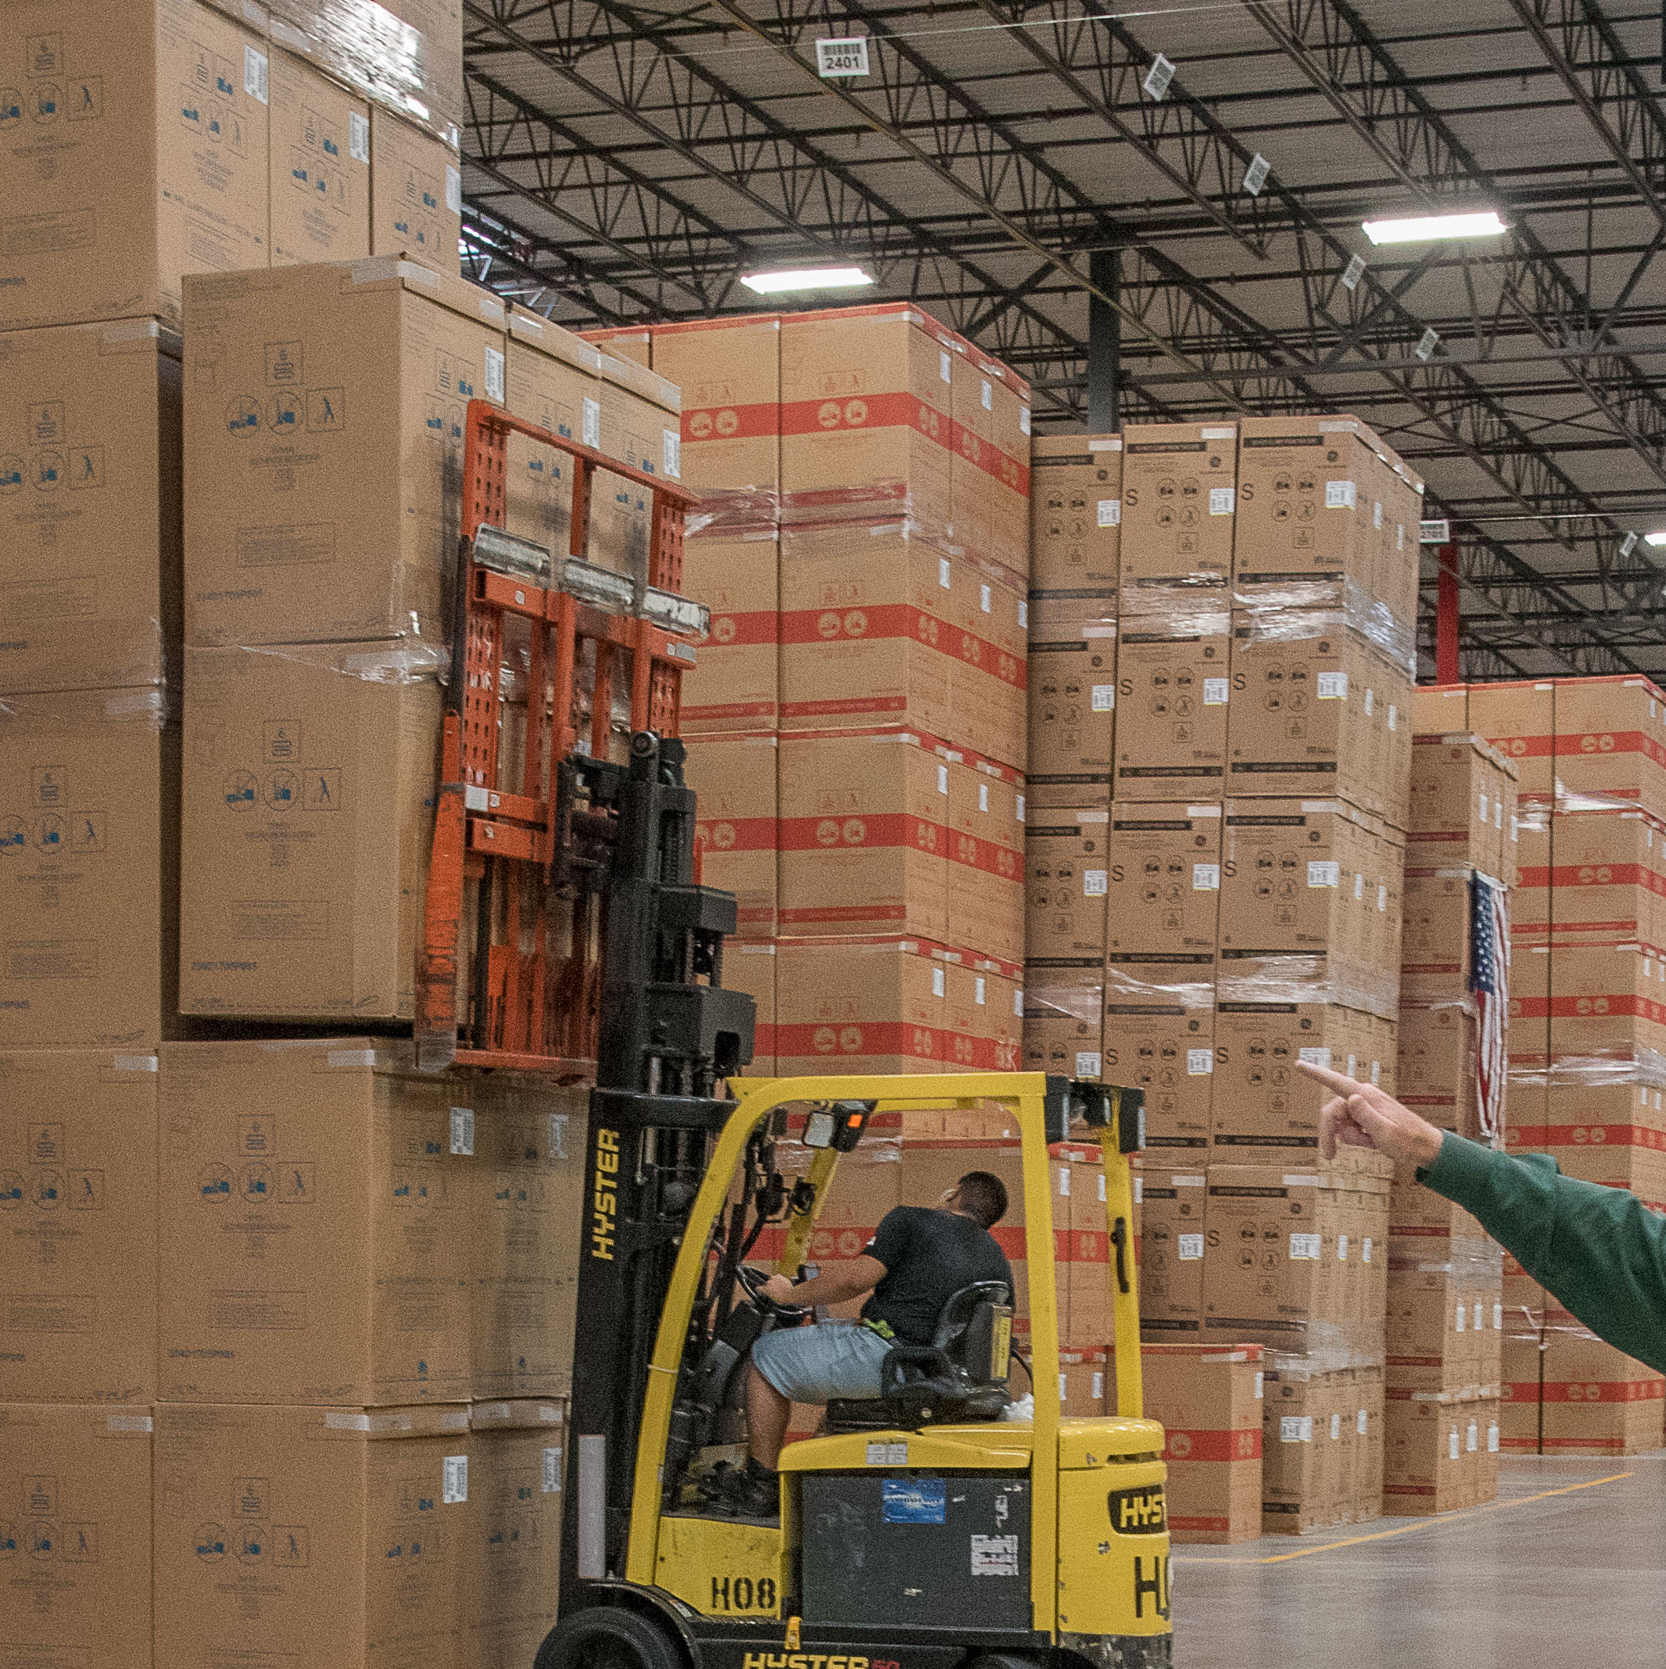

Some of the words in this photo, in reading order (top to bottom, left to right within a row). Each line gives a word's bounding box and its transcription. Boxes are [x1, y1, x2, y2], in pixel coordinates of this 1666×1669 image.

[826, 55, 860, 71] 2401
[1124, 489, 1139, 507] S
[1240, 483, 1255, 501] S
[1119, 678, 1134, 696] S
[1233, 673, 1247, 691] S
[1112, 865, 1125, 882] S
[1225, 861, 1238, 878] S
[1105, 1048, 1119, 1066] S
[1216, 1046, 1230, 1065] S
[591, 1128, 620, 1260] HYSTER
[1208, 1230, 1221, 1248] S
